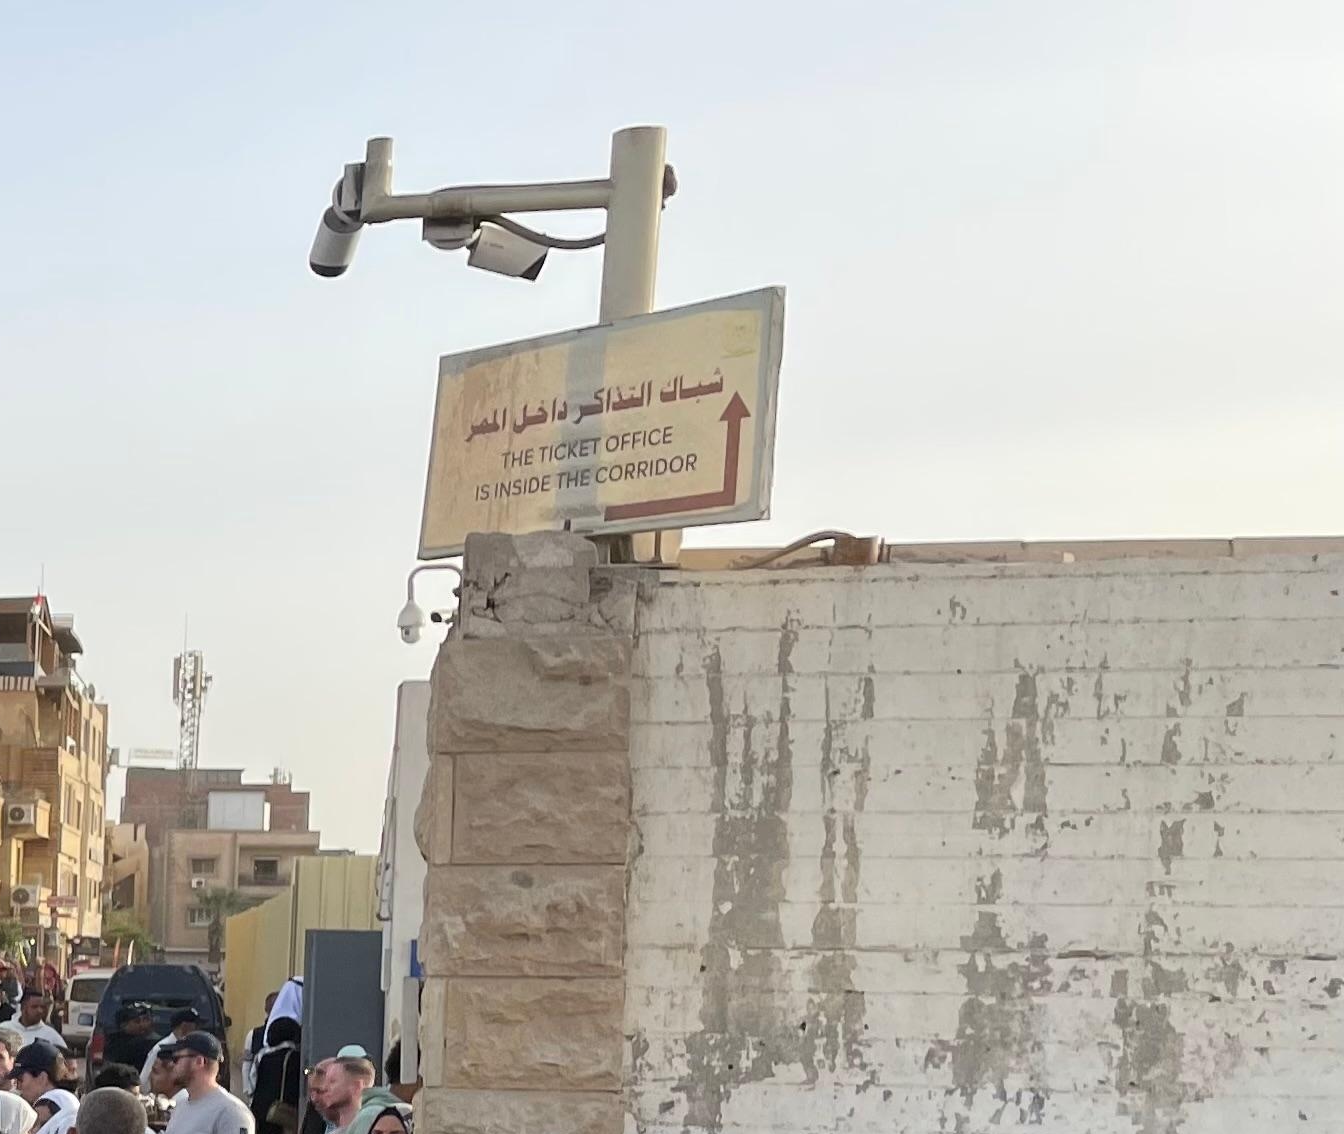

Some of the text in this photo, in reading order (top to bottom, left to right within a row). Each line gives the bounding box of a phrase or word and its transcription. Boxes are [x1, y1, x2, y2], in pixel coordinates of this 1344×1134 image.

[465, 368, 724, 443] شباك التذاكر داخل الممر
[501, 425, 674, 470] THE TICKET OFFICE
[475, 453, 698, 502] IS INSIDE THE CORRIDOR
